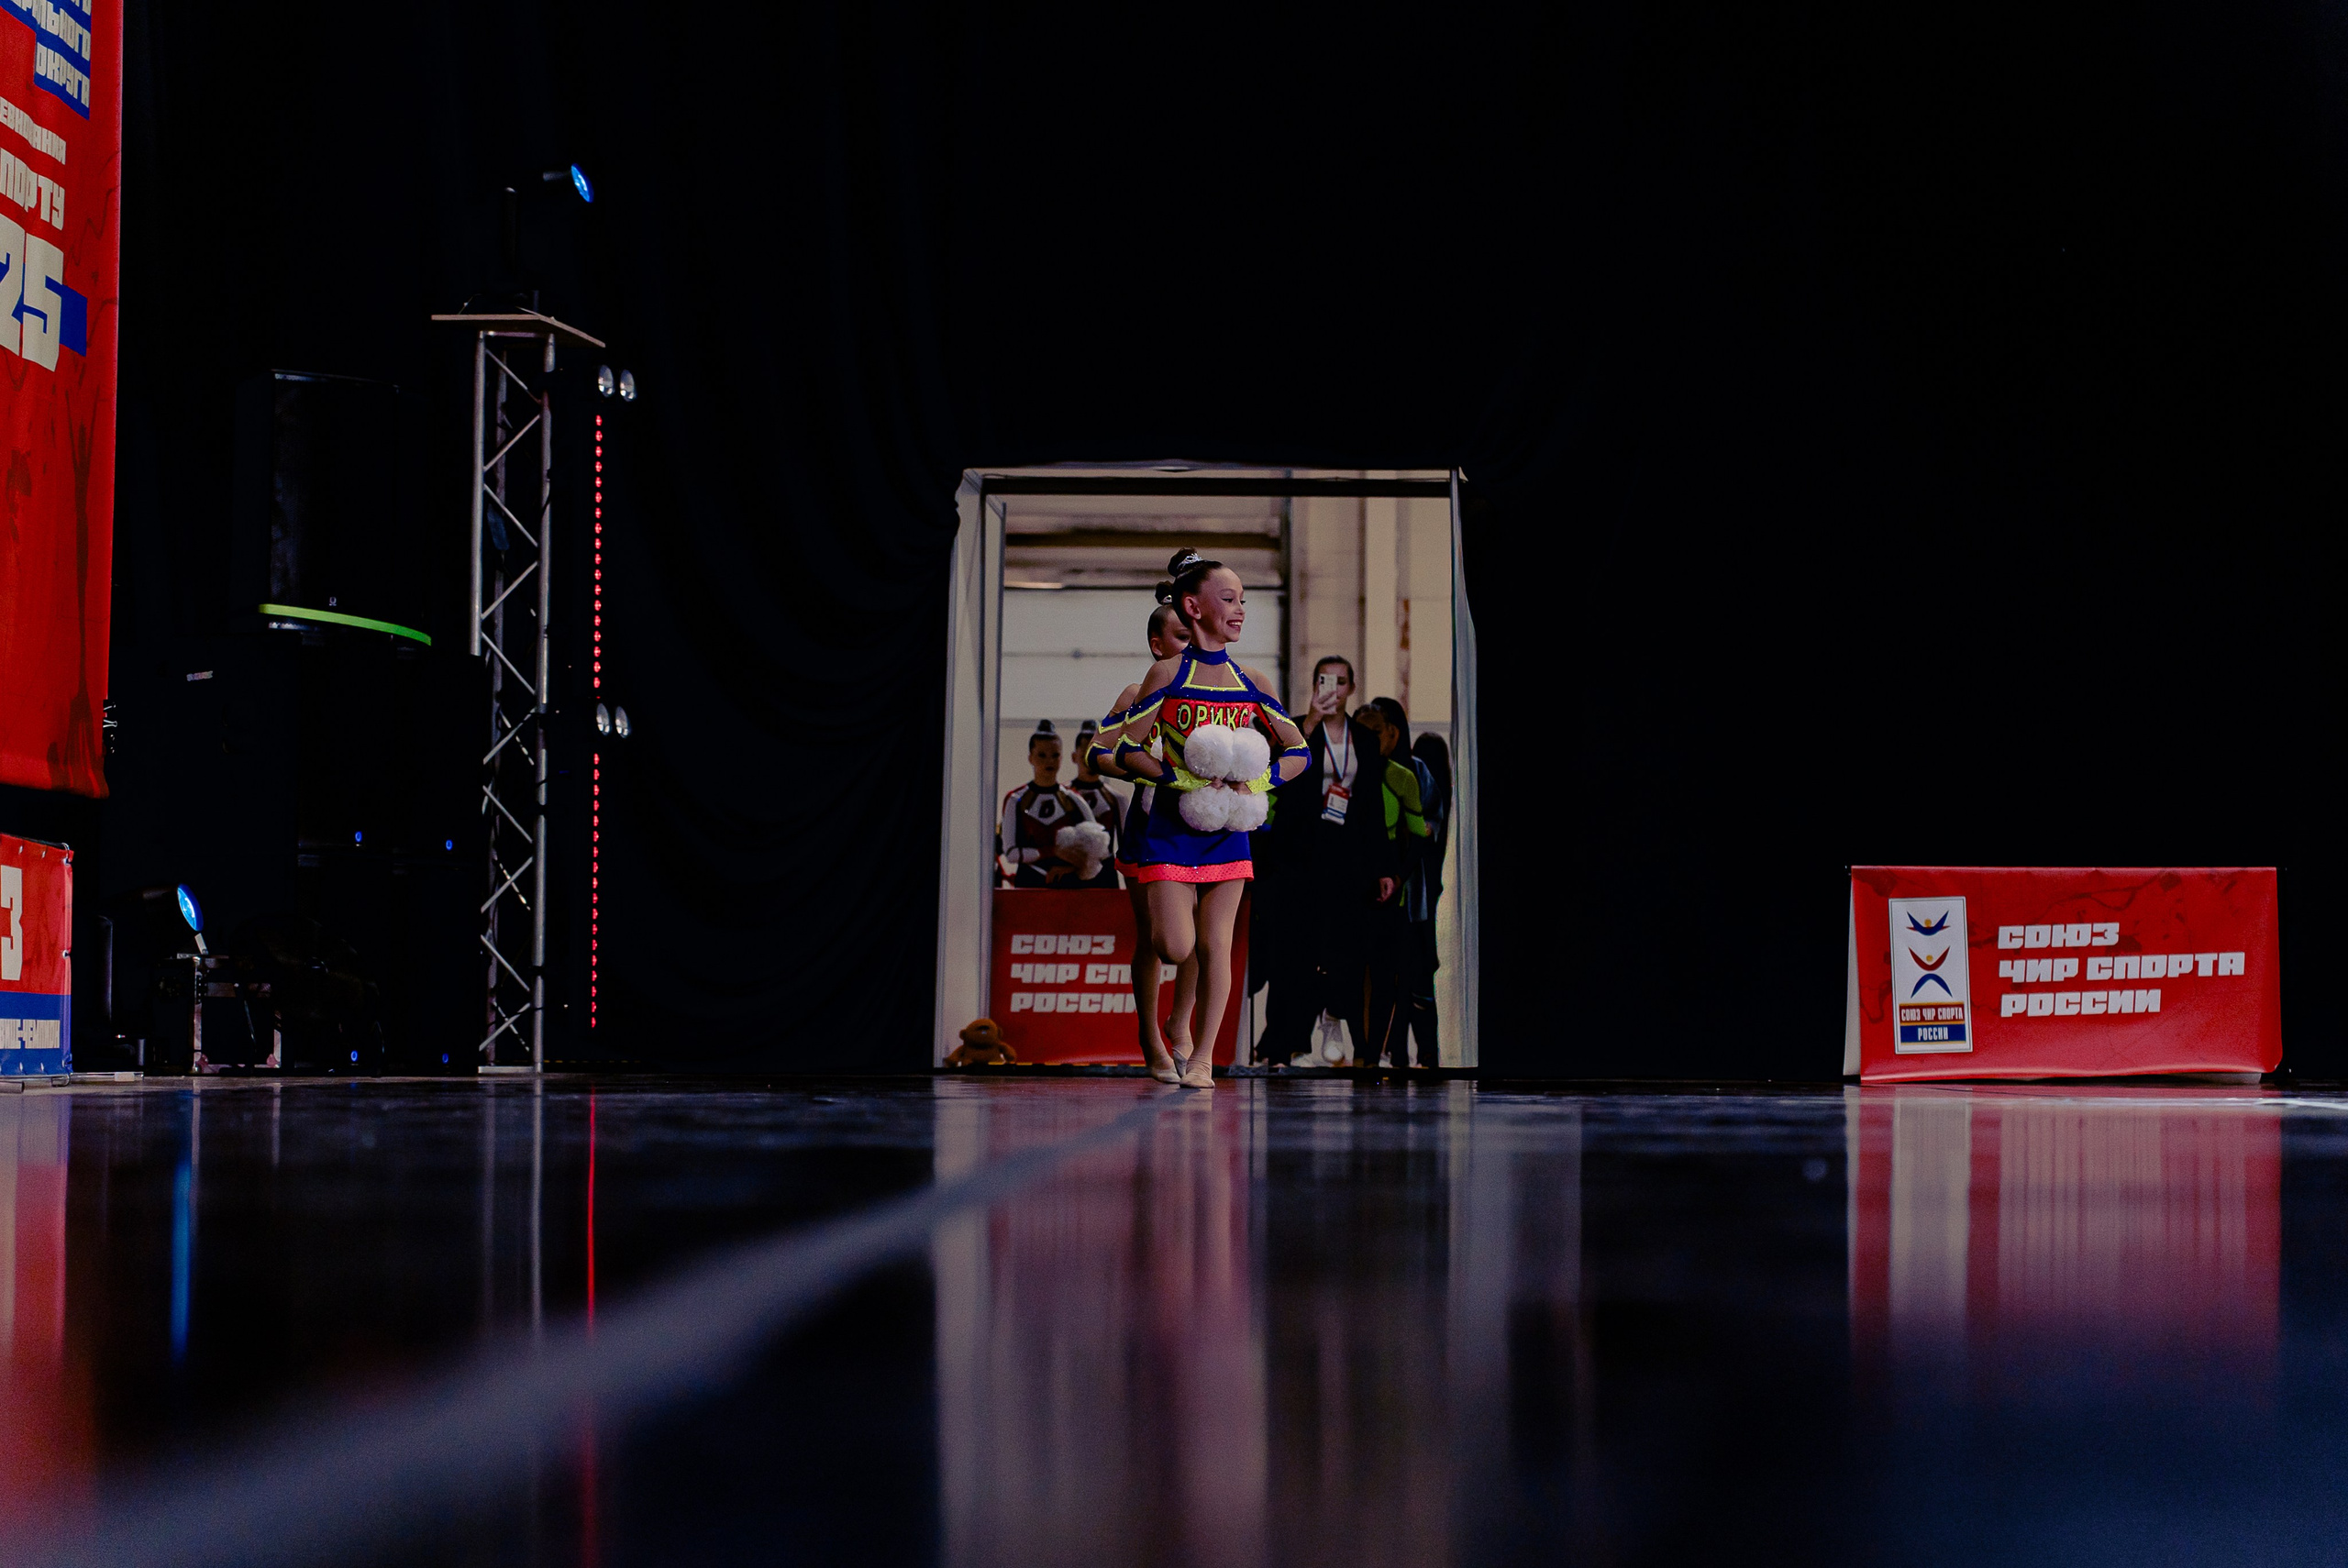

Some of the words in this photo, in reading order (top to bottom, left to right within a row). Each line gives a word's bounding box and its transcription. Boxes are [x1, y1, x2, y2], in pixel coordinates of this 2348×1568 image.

[36, 42, 90, 108] ОКРУГА
[0, 96, 66, 165] ЕВНОВАНИЯ
[0, 147, 65, 230] ПОРТУ
[1011, 934, 1115, 955] СОЮЗ
[1998, 922, 2120, 949] СОЮЗ
[1011, 963, 1080, 984] ЧИР
[1085, 964, 1178, 984] СПР
[1999, 958, 2079, 983] ЧИР
[2087, 952, 2245, 980] СПОРТА
[1901, 1009, 1921, 1021] СОЮЗ
[1922, 1008, 1936, 1021] ЧИР
[1937, 1007, 1964, 1021] СПОРТА
[2000, 988, 2161, 1017] РОССИИ
[1918, 1027, 1949, 1041] РОССИИ
